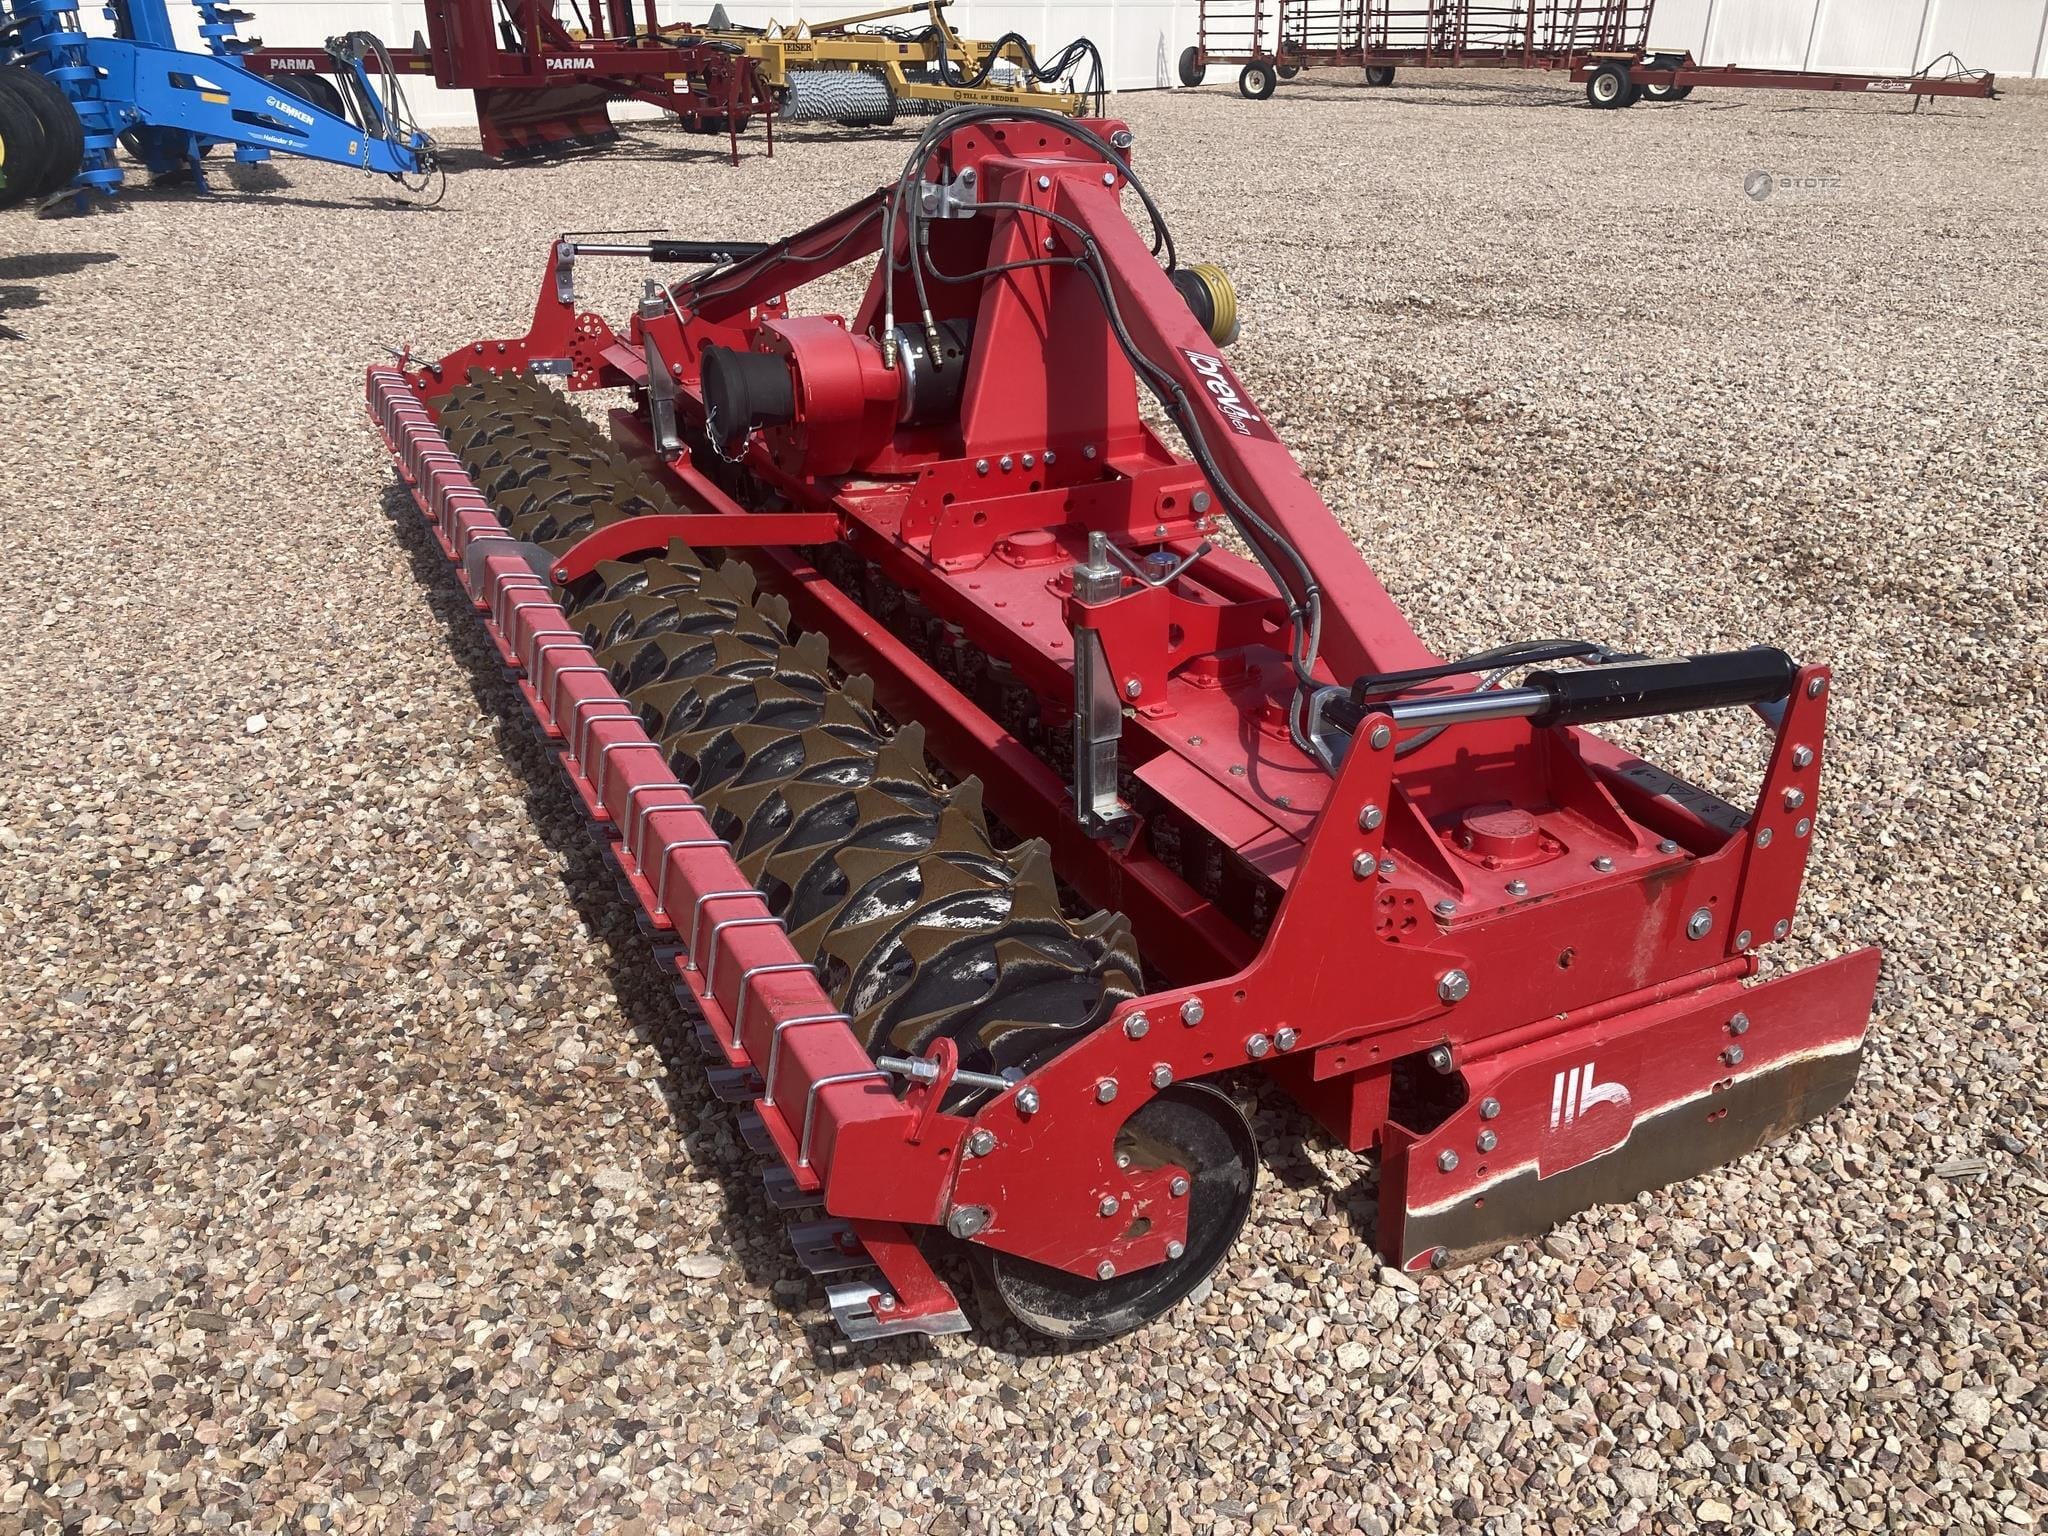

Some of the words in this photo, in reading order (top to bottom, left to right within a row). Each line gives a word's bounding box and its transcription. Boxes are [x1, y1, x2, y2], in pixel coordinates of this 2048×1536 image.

[270, 58, 316, 70] PARMA
[545, 57, 595, 69] PARMA
[275, 101, 314, 125] LEMKEN
